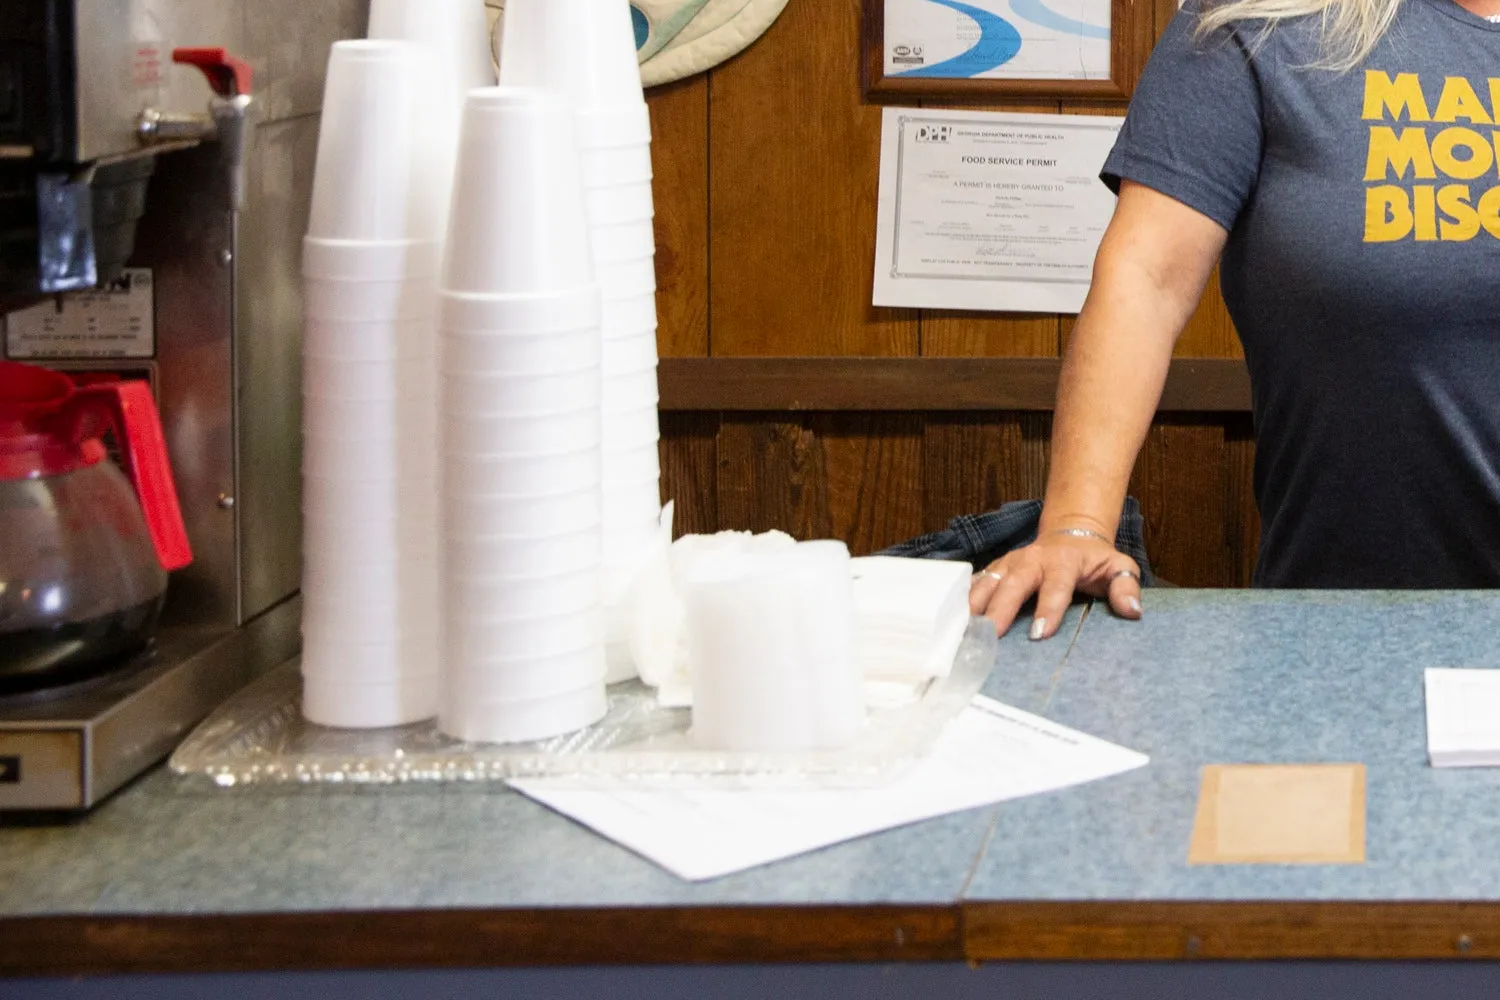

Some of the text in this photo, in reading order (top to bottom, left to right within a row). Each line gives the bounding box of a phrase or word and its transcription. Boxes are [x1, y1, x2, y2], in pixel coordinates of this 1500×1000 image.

[962, 156, 1057, 167] FOOD SERVICE PERMIT
